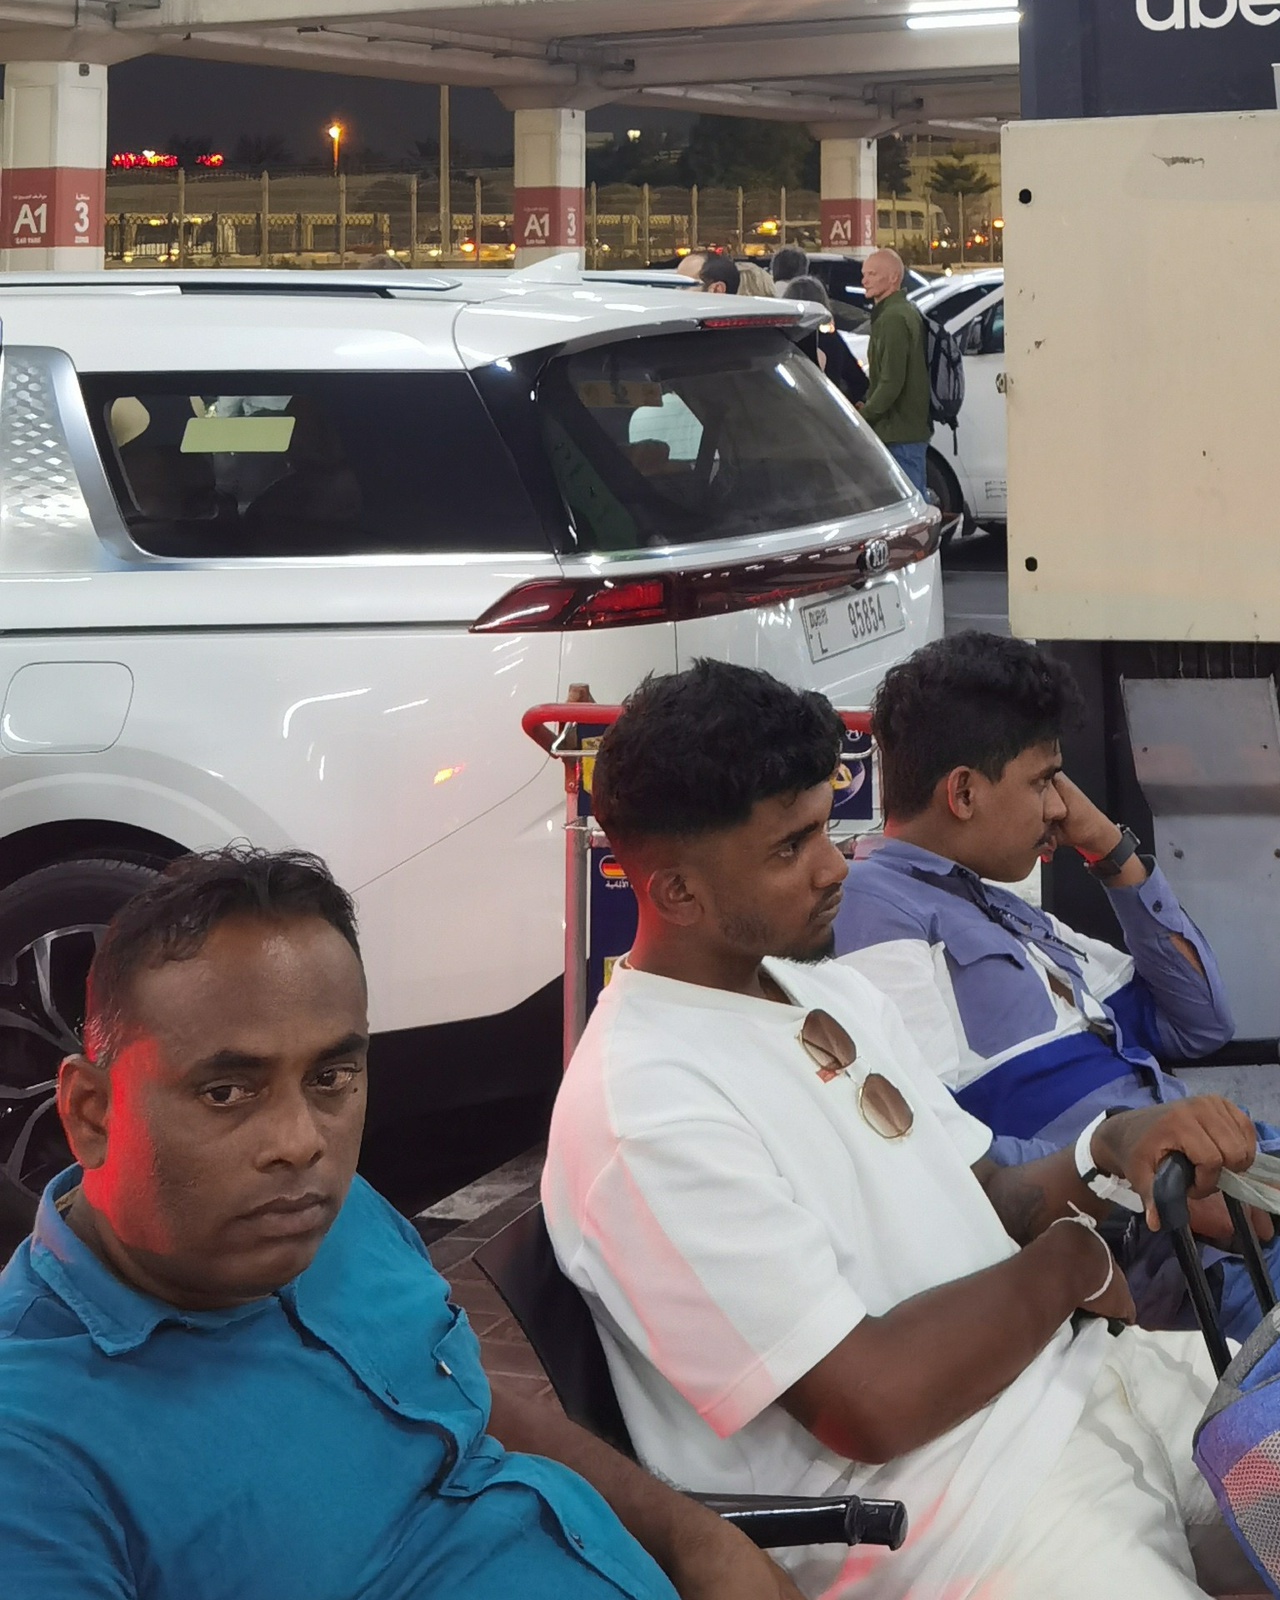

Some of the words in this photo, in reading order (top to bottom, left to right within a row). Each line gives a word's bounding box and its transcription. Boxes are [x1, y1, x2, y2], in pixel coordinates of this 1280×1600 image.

[12, 203, 47, 234] A1
[74, 201, 90, 233] 3
[524, 213, 550, 237] A1
[567, 212, 577, 237] 3
[830, 219, 852, 241] A1
[847, 592, 887, 640] 95854
[818, 631, 829, 655] L
